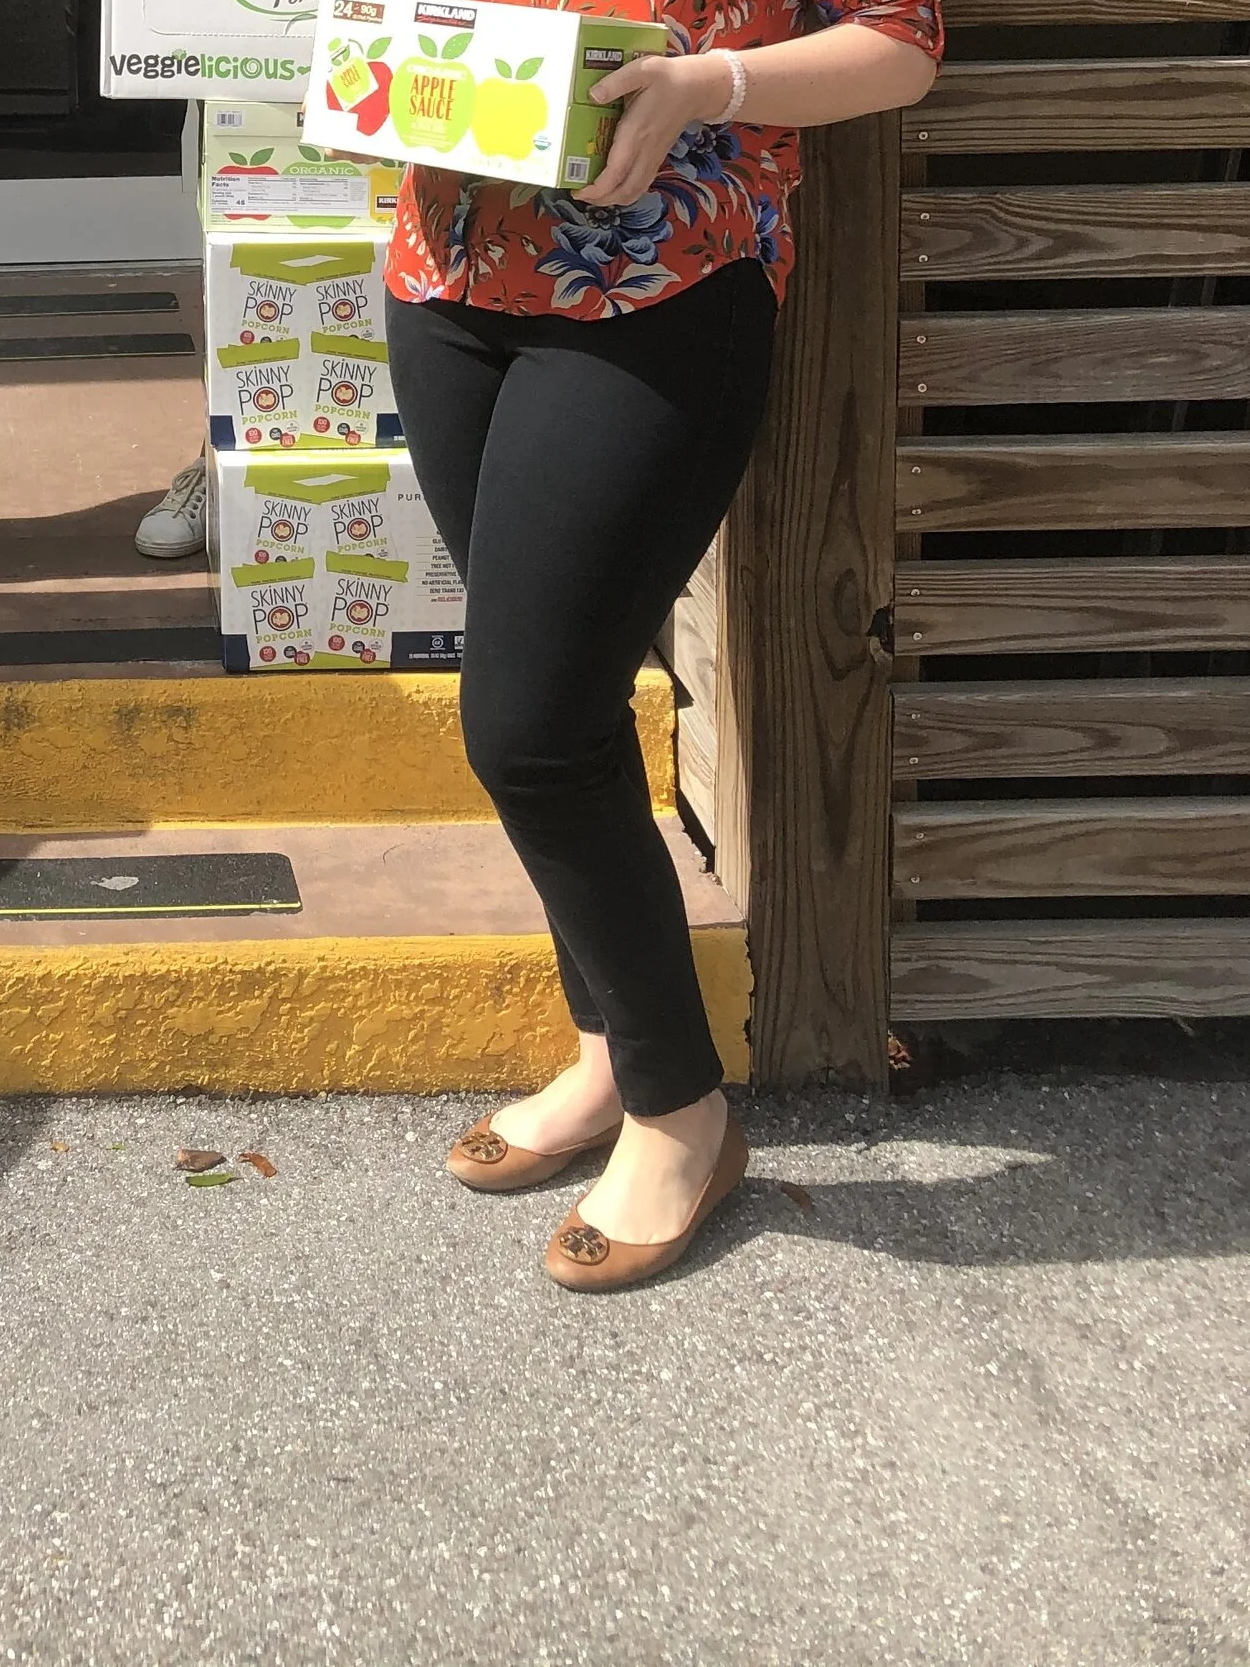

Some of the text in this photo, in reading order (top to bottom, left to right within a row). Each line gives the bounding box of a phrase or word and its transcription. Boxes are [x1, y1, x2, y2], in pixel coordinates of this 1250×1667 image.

[333, 0, 354, 17] 24
[417, 3, 477, 22] KIRKLAND
[109, 49, 295, 81] veggielicious
[410, 74, 457, 101] APPLE
[409, 96, 453, 122] SAUCE
[290, 166, 354, 175] ORGANIC
[248, 280, 297, 303] SKINNY
[316, 279, 366, 301] SKINNY
[243, 296, 294, 324] POP
[318, 295, 368, 325] POP
[241, 319, 290, 335] POPCORN
[322, 319, 373, 333] POPCORN
[236, 365, 290, 389] SKINNY
[321, 359, 377, 384] SKINNY
[238, 384, 294, 416] POP
[316, 378, 374, 409] POP
[242, 410, 298, 425] POPCORN
[314, 404, 371, 420] POPCORN
[263, 500, 312, 522] SKINNY
[331, 498, 380, 521] SKINNY
[257, 516, 309, 544] POP
[333, 514, 384, 544] POP
[255, 539, 305, 554] POPCORN
[337, 537, 388, 553] POPCORN
[250, 585, 305, 608] SKINNY
[335, 578, 393, 602] SKINNY
[253, 603, 309, 634] POP
[331, 597, 389, 627] POP
[256, 629, 312, 644] POPCORN
[328, 622, 387, 638] POPCORN
